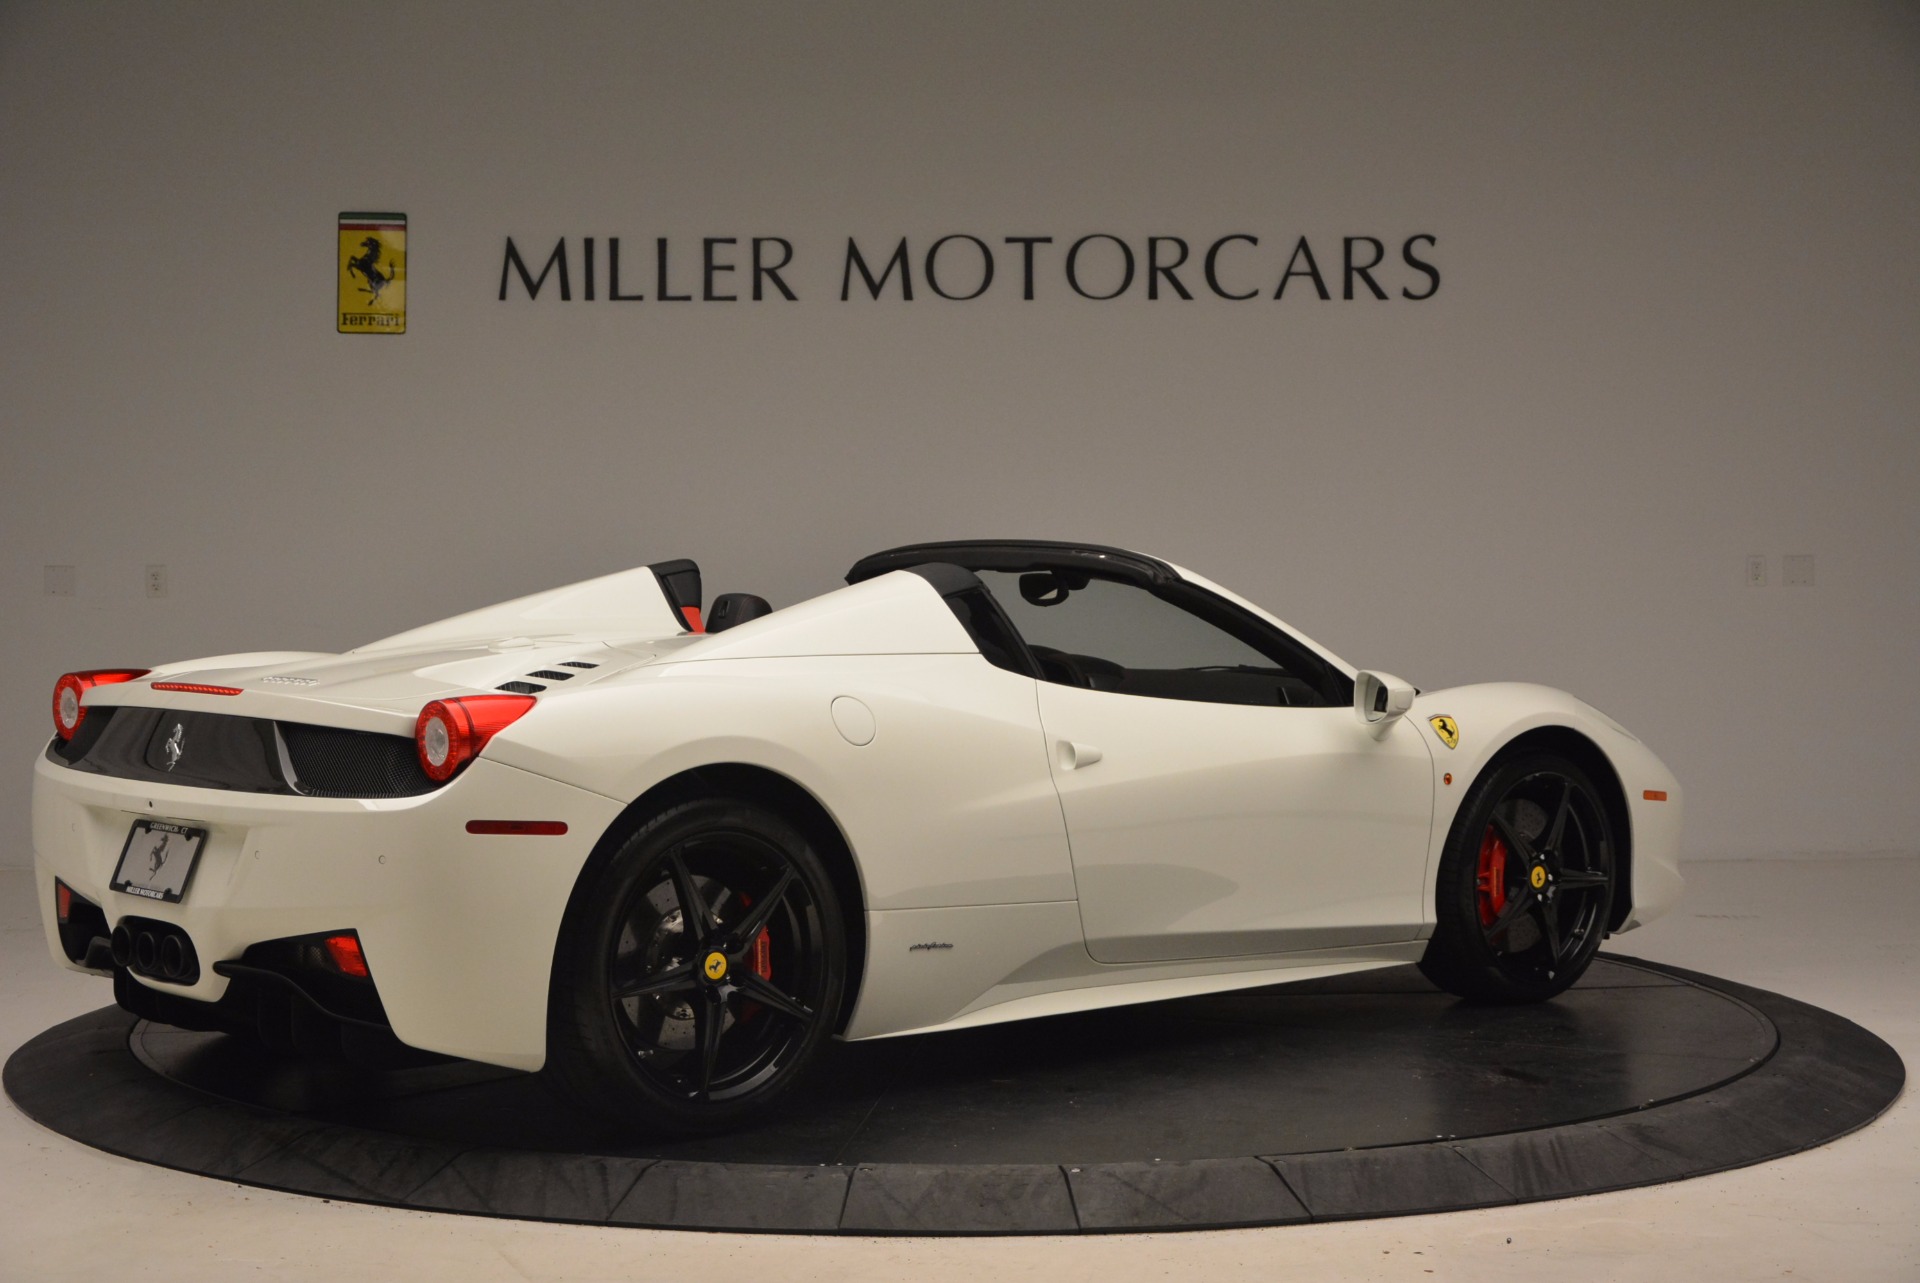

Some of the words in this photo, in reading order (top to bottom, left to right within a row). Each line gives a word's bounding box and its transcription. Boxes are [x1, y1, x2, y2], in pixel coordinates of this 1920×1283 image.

[498, 234, 799, 301] MILLER
[841, 234, 1441, 301] MOTORCARS
[341, 313, 401, 326] Ferrari
